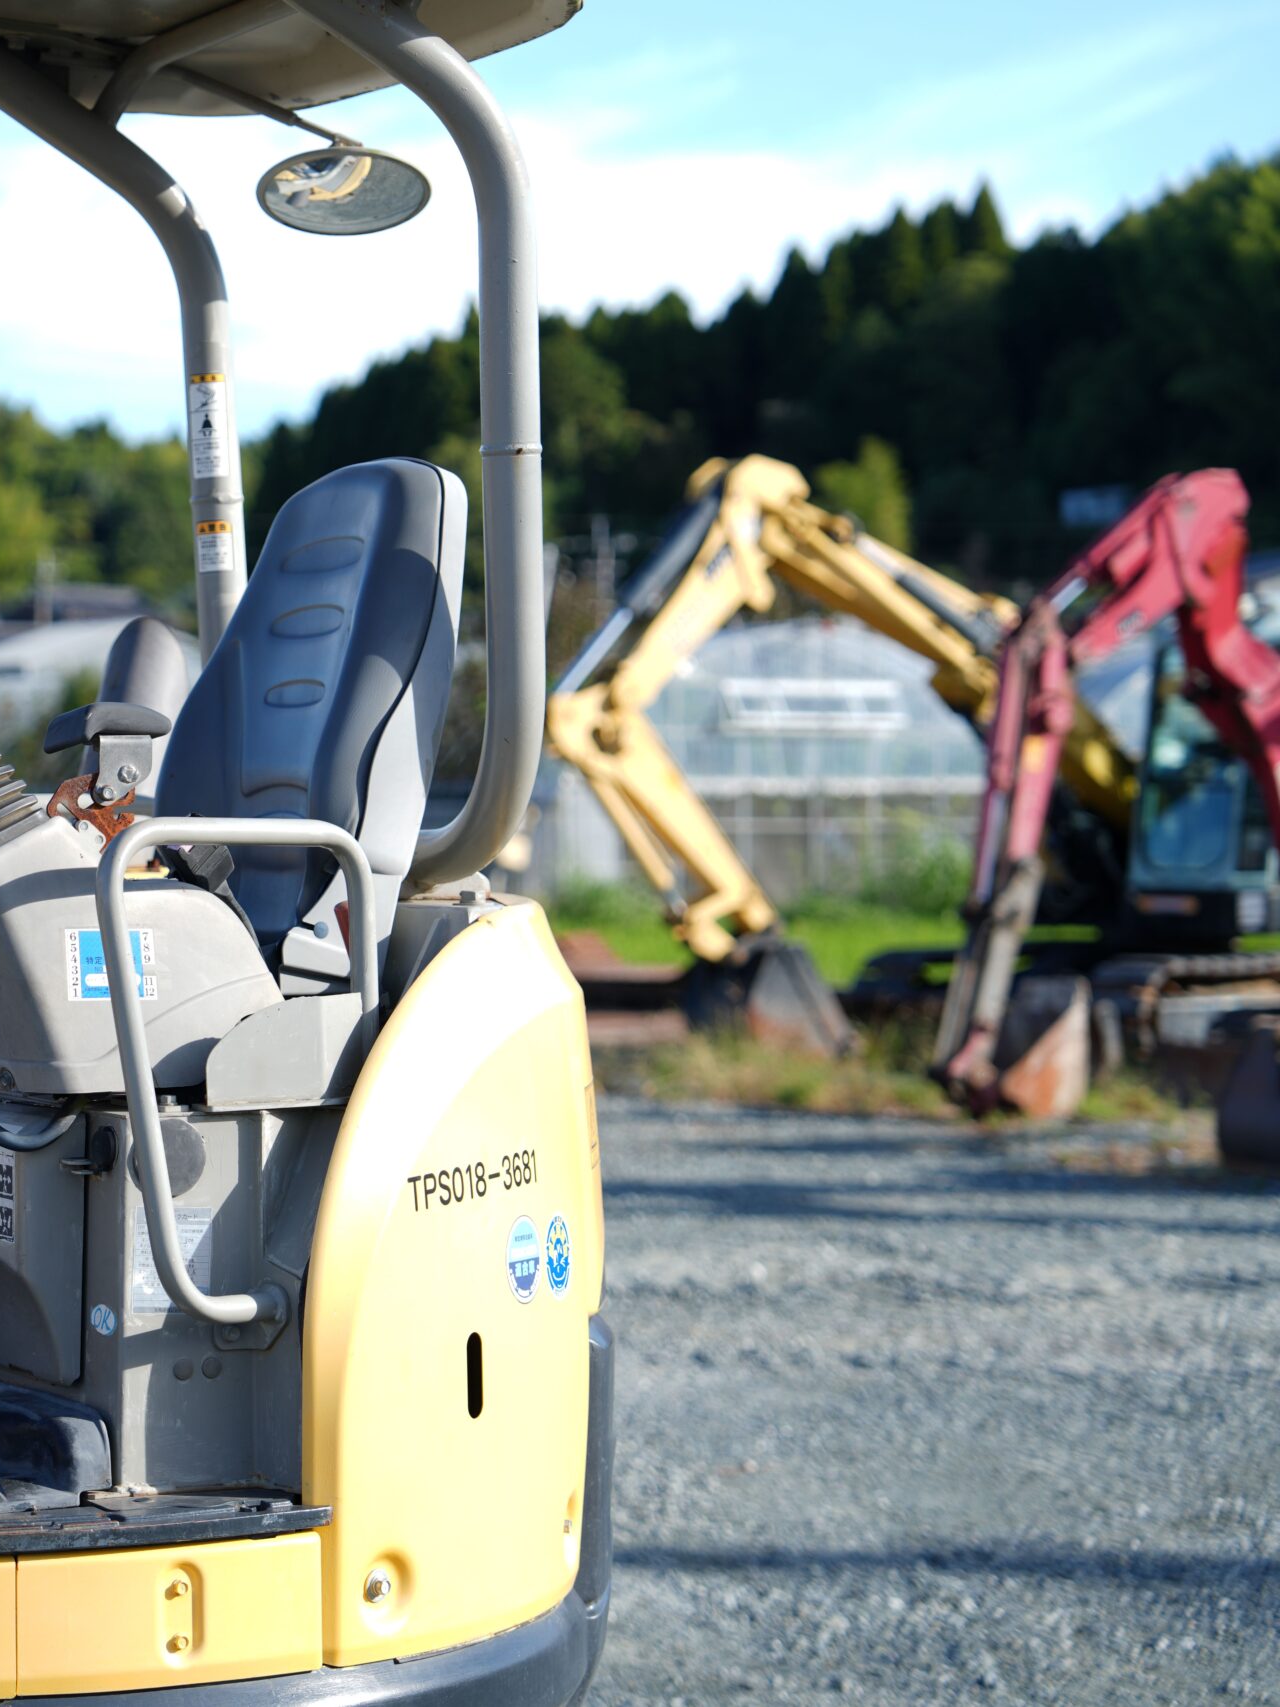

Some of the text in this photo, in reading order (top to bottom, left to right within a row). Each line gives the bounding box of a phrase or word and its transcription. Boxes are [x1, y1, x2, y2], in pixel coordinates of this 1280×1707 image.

[70, 932, 77, 941] 6
[142, 932, 149, 941] 7
[70, 943, 77, 953] 5
[143, 943, 150, 952] 8
[70, 954, 77, 964] 4
[144, 954, 150, 964] 9
[71, 965, 78, 975] 3
[72, 976, 79, 986] 2
[144, 977, 153, 986] 11
[73, 988, 78, 998] 1
[145, 988, 155, 997] 12
[407, 1149, 537, 1212] TPS018-3681
[93, 1307, 111, 1331] OK
